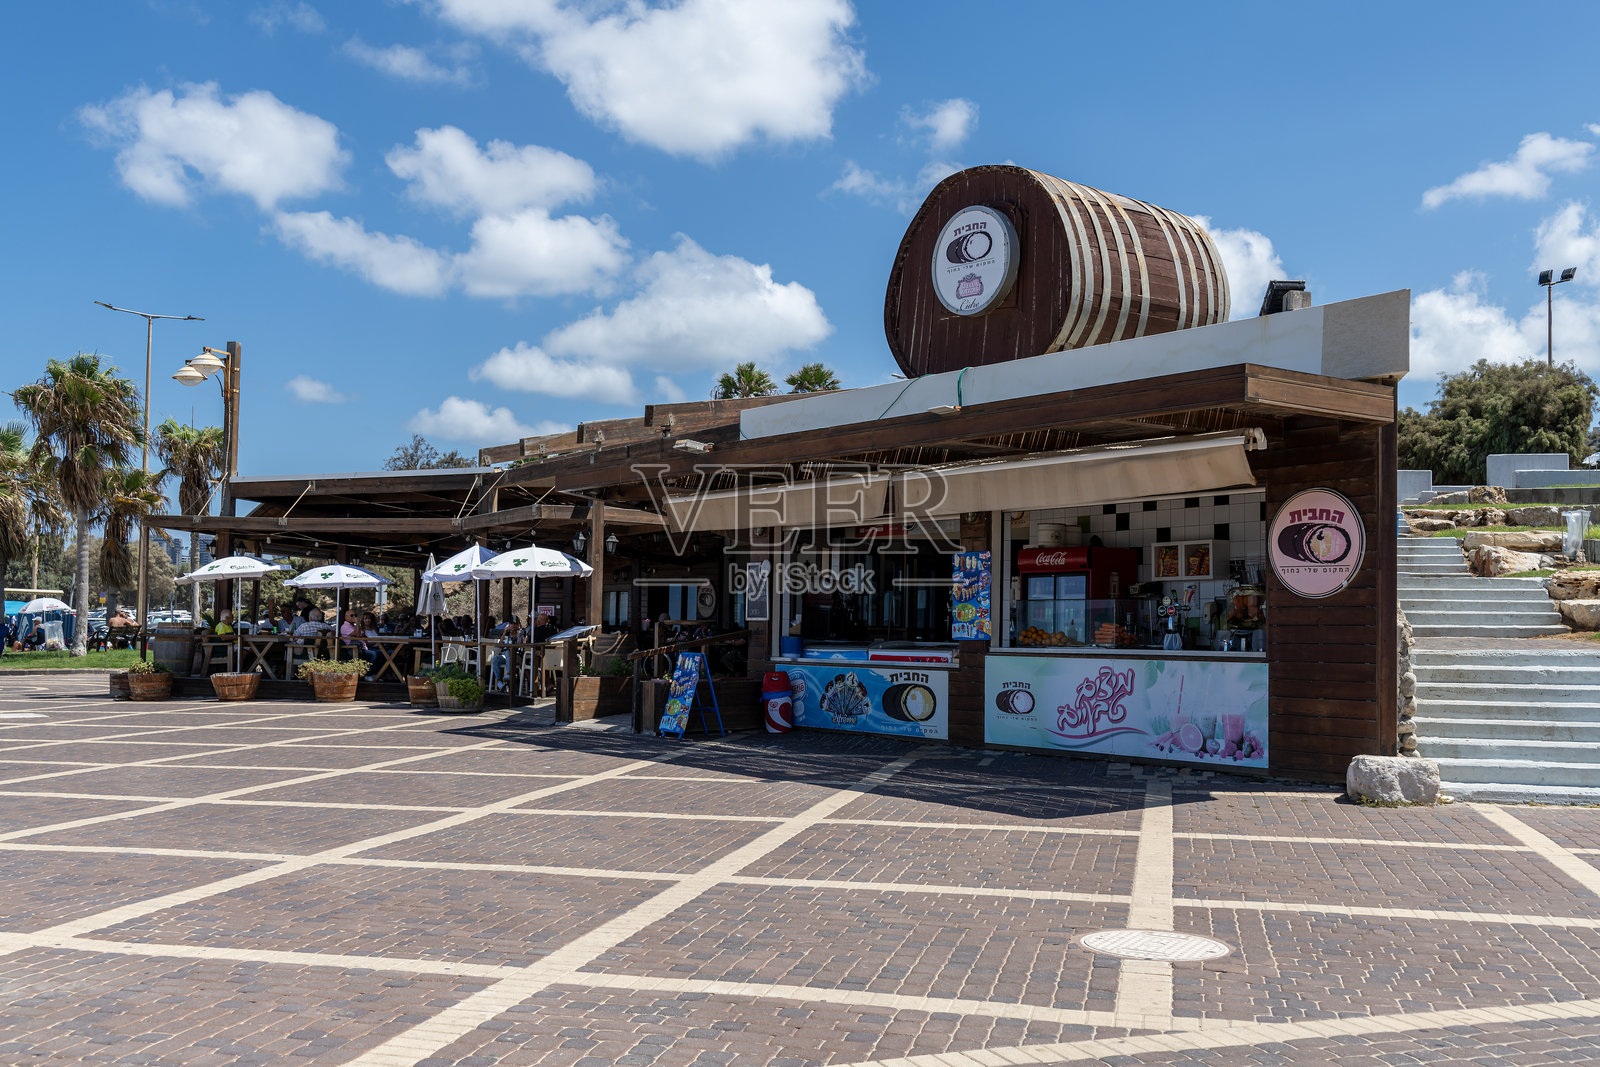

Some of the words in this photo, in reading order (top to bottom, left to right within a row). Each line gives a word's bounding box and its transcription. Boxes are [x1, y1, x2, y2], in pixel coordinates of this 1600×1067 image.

[953, 221, 987, 237] החבית
[1289, 508, 1345, 524] החבית
[889, 671, 929, 684] החבית
[1001, 681, 1031, 690] החבית
[1075, 666, 1136, 709] מיצים
